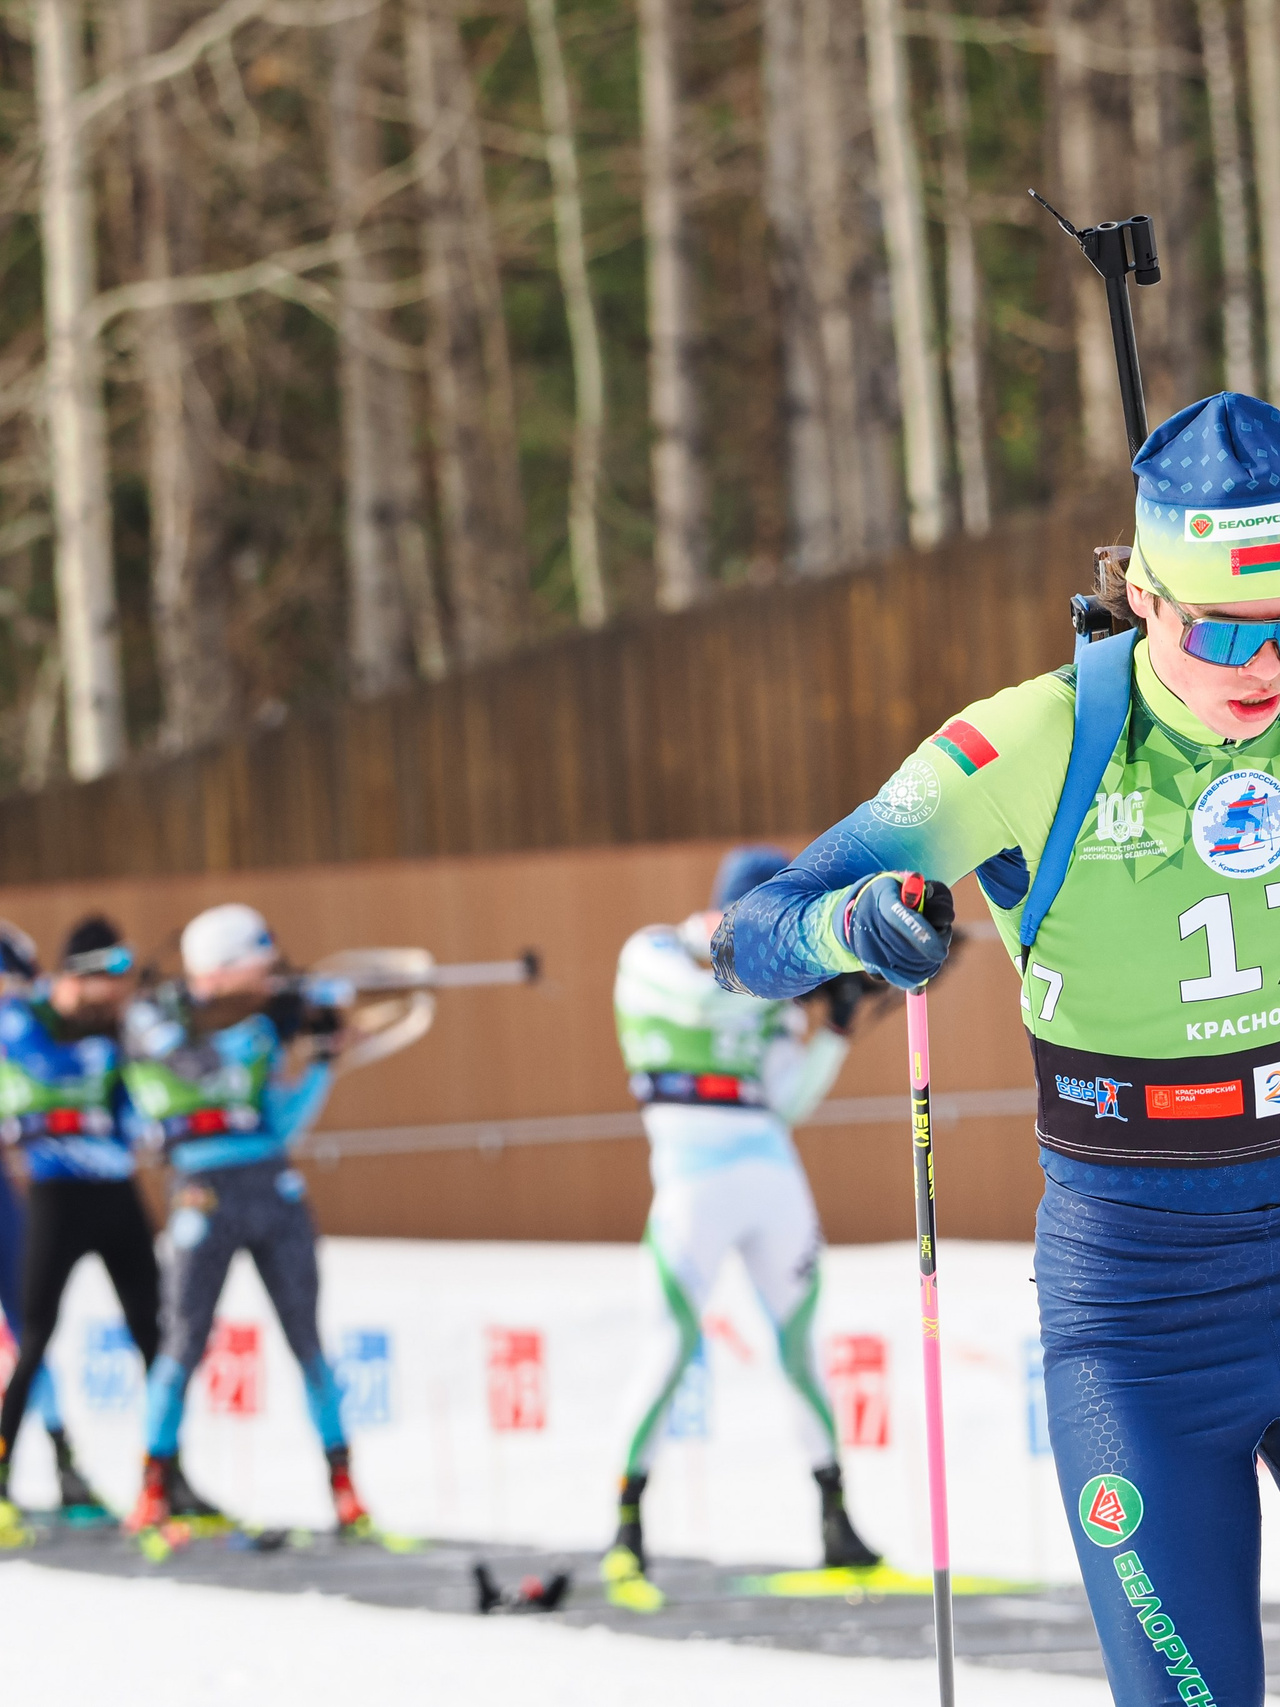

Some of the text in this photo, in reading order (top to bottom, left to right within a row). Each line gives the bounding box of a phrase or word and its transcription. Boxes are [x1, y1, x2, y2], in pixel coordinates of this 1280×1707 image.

[901, 761, 938, 798] IATHLON
[1197, 771, 1247, 812] ПЕРВЕНСТВО
[881, 811, 894, 820] of
[894, 804, 932, 824] Belarus
[1079, 846, 1168, 861] РОССИЙСКОЙ ФЕДЕРАЦИИ
[1083, 839, 1164, 854] МИНИСТЕРСТВО СПОРТА
[1218, 862, 1267, 874] Красноярск
[1056, 1081, 1095, 1100] СБР
[1175, 1084, 1236, 1096] КРАСНОЯРСКИЙ
[1175, 1094, 1196, 1102] КРАЙ
[912, 1098, 929, 1148] LEKI
[920, 1234, 932, 1259] HRC
